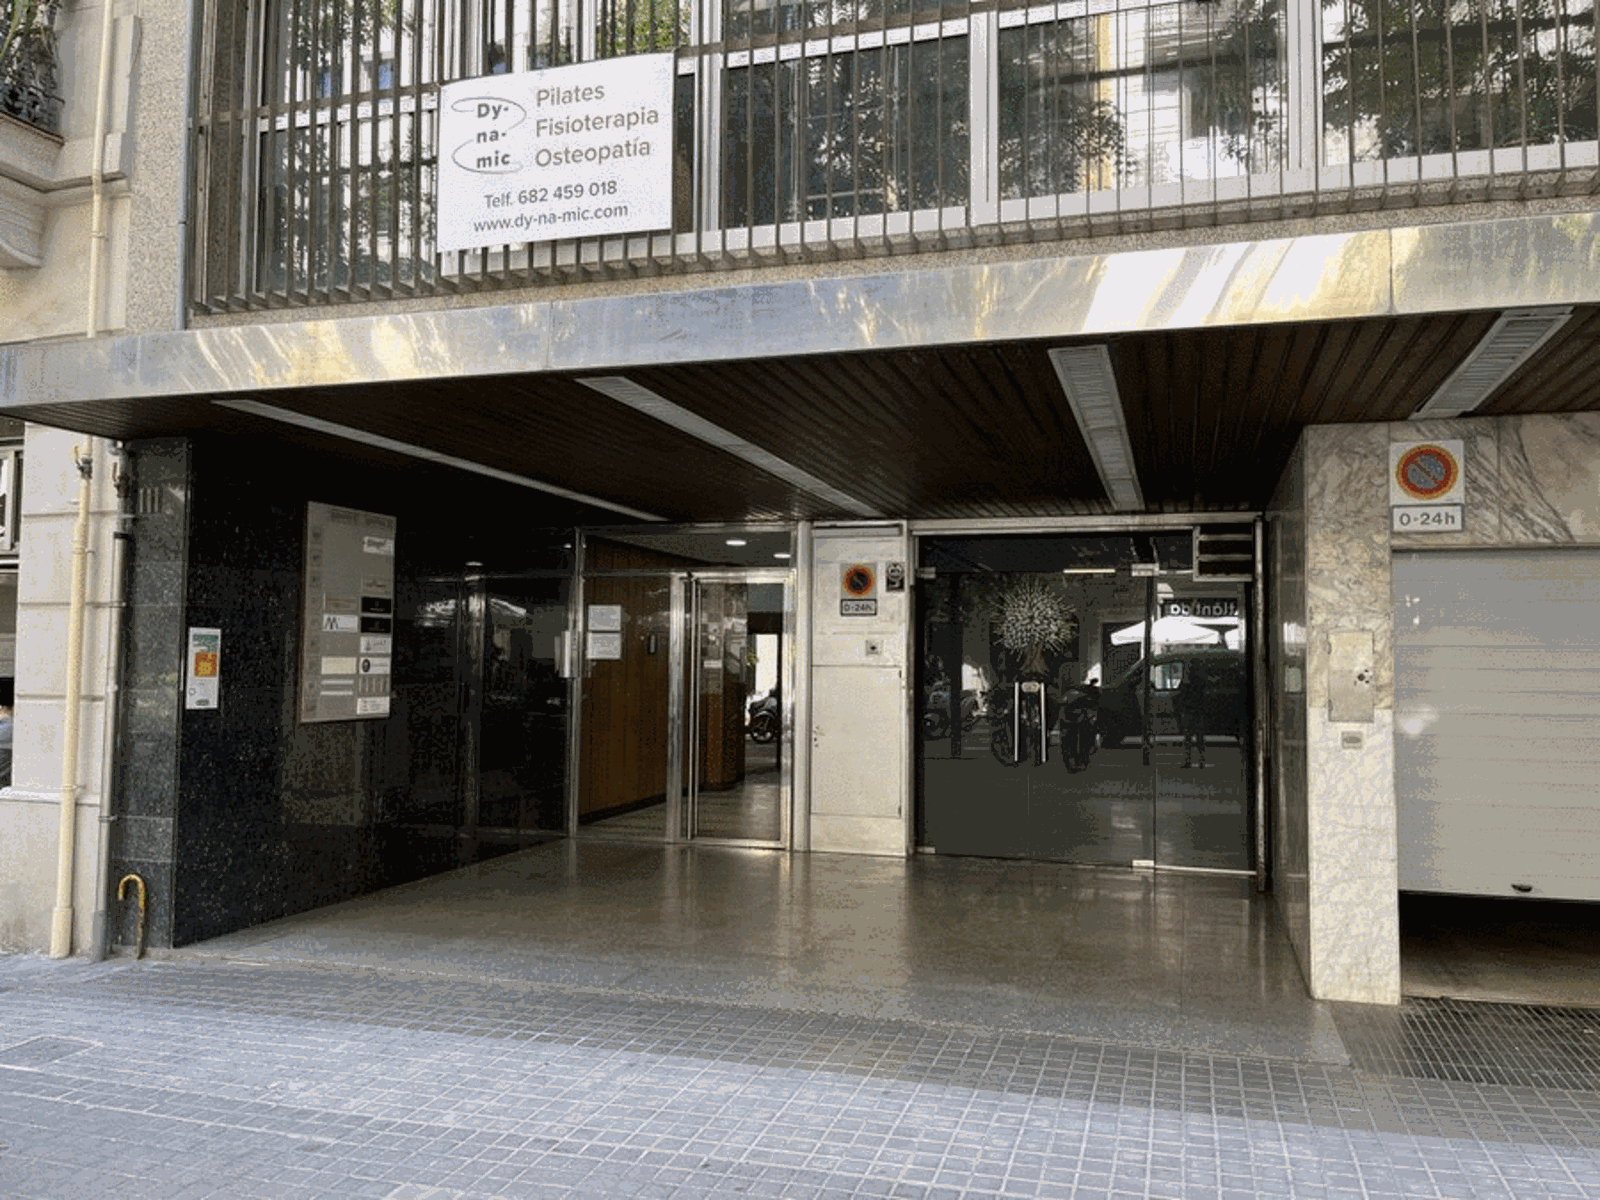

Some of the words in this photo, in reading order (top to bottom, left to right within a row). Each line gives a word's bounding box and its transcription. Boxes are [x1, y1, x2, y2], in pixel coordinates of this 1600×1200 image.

[536, 84, 605, 107] Pilates
[536, 107, 660, 137] Fisioterapia
[476, 150, 511, 169] mic
[535, 136, 651, 167] Osteopatía
[484, 192, 513, 209] Telf.
[518, 188, 548, 205] 682
[553, 184, 584, 200] 459
[589, 180, 618, 196] 018
[473, 204, 629, 232] www.dy-na-mic.com
